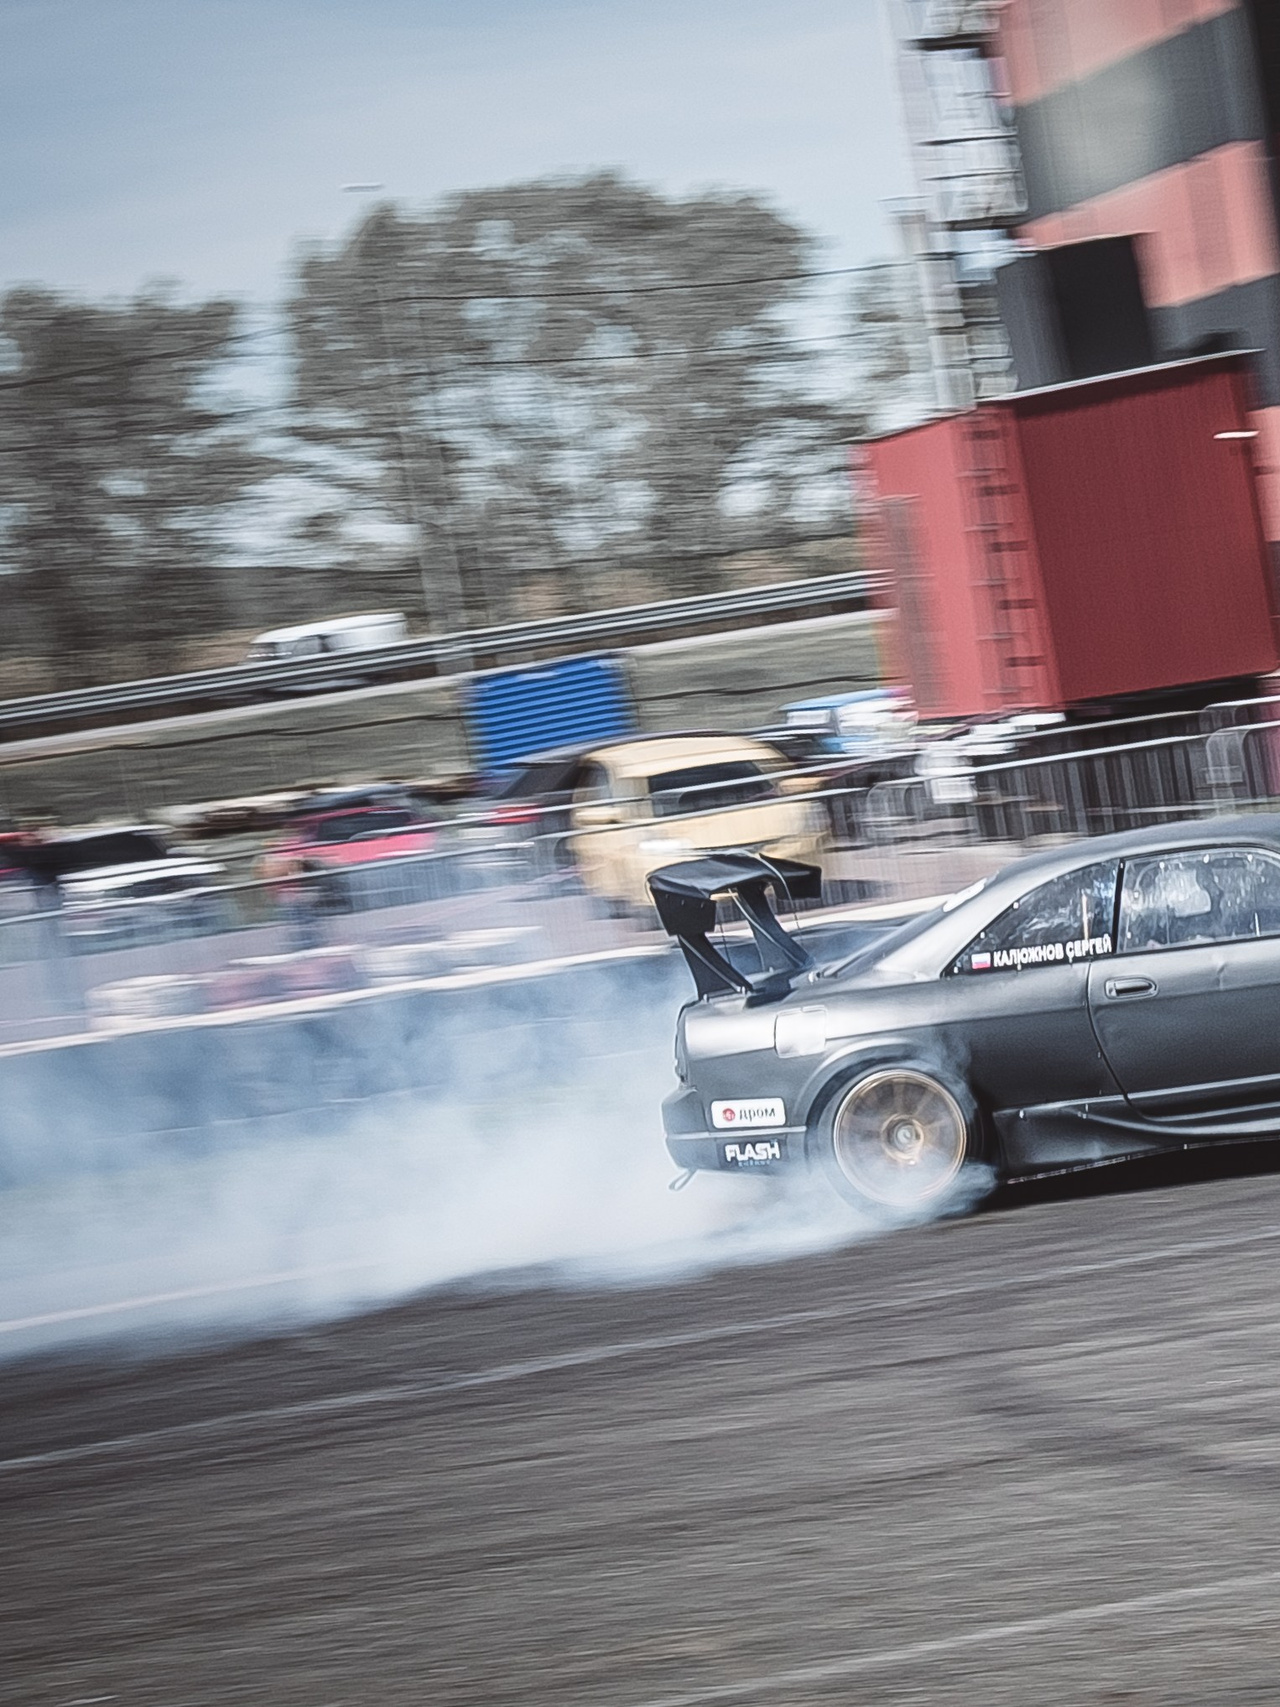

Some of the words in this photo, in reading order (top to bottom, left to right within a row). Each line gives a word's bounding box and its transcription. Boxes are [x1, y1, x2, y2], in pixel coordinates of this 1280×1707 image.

[993, 943, 1064, 967] КАЛЮЖНОВ
[1065, 933, 1112, 958] СЕРГЕЙ
[725, 1141, 780, 1162] FLASH
